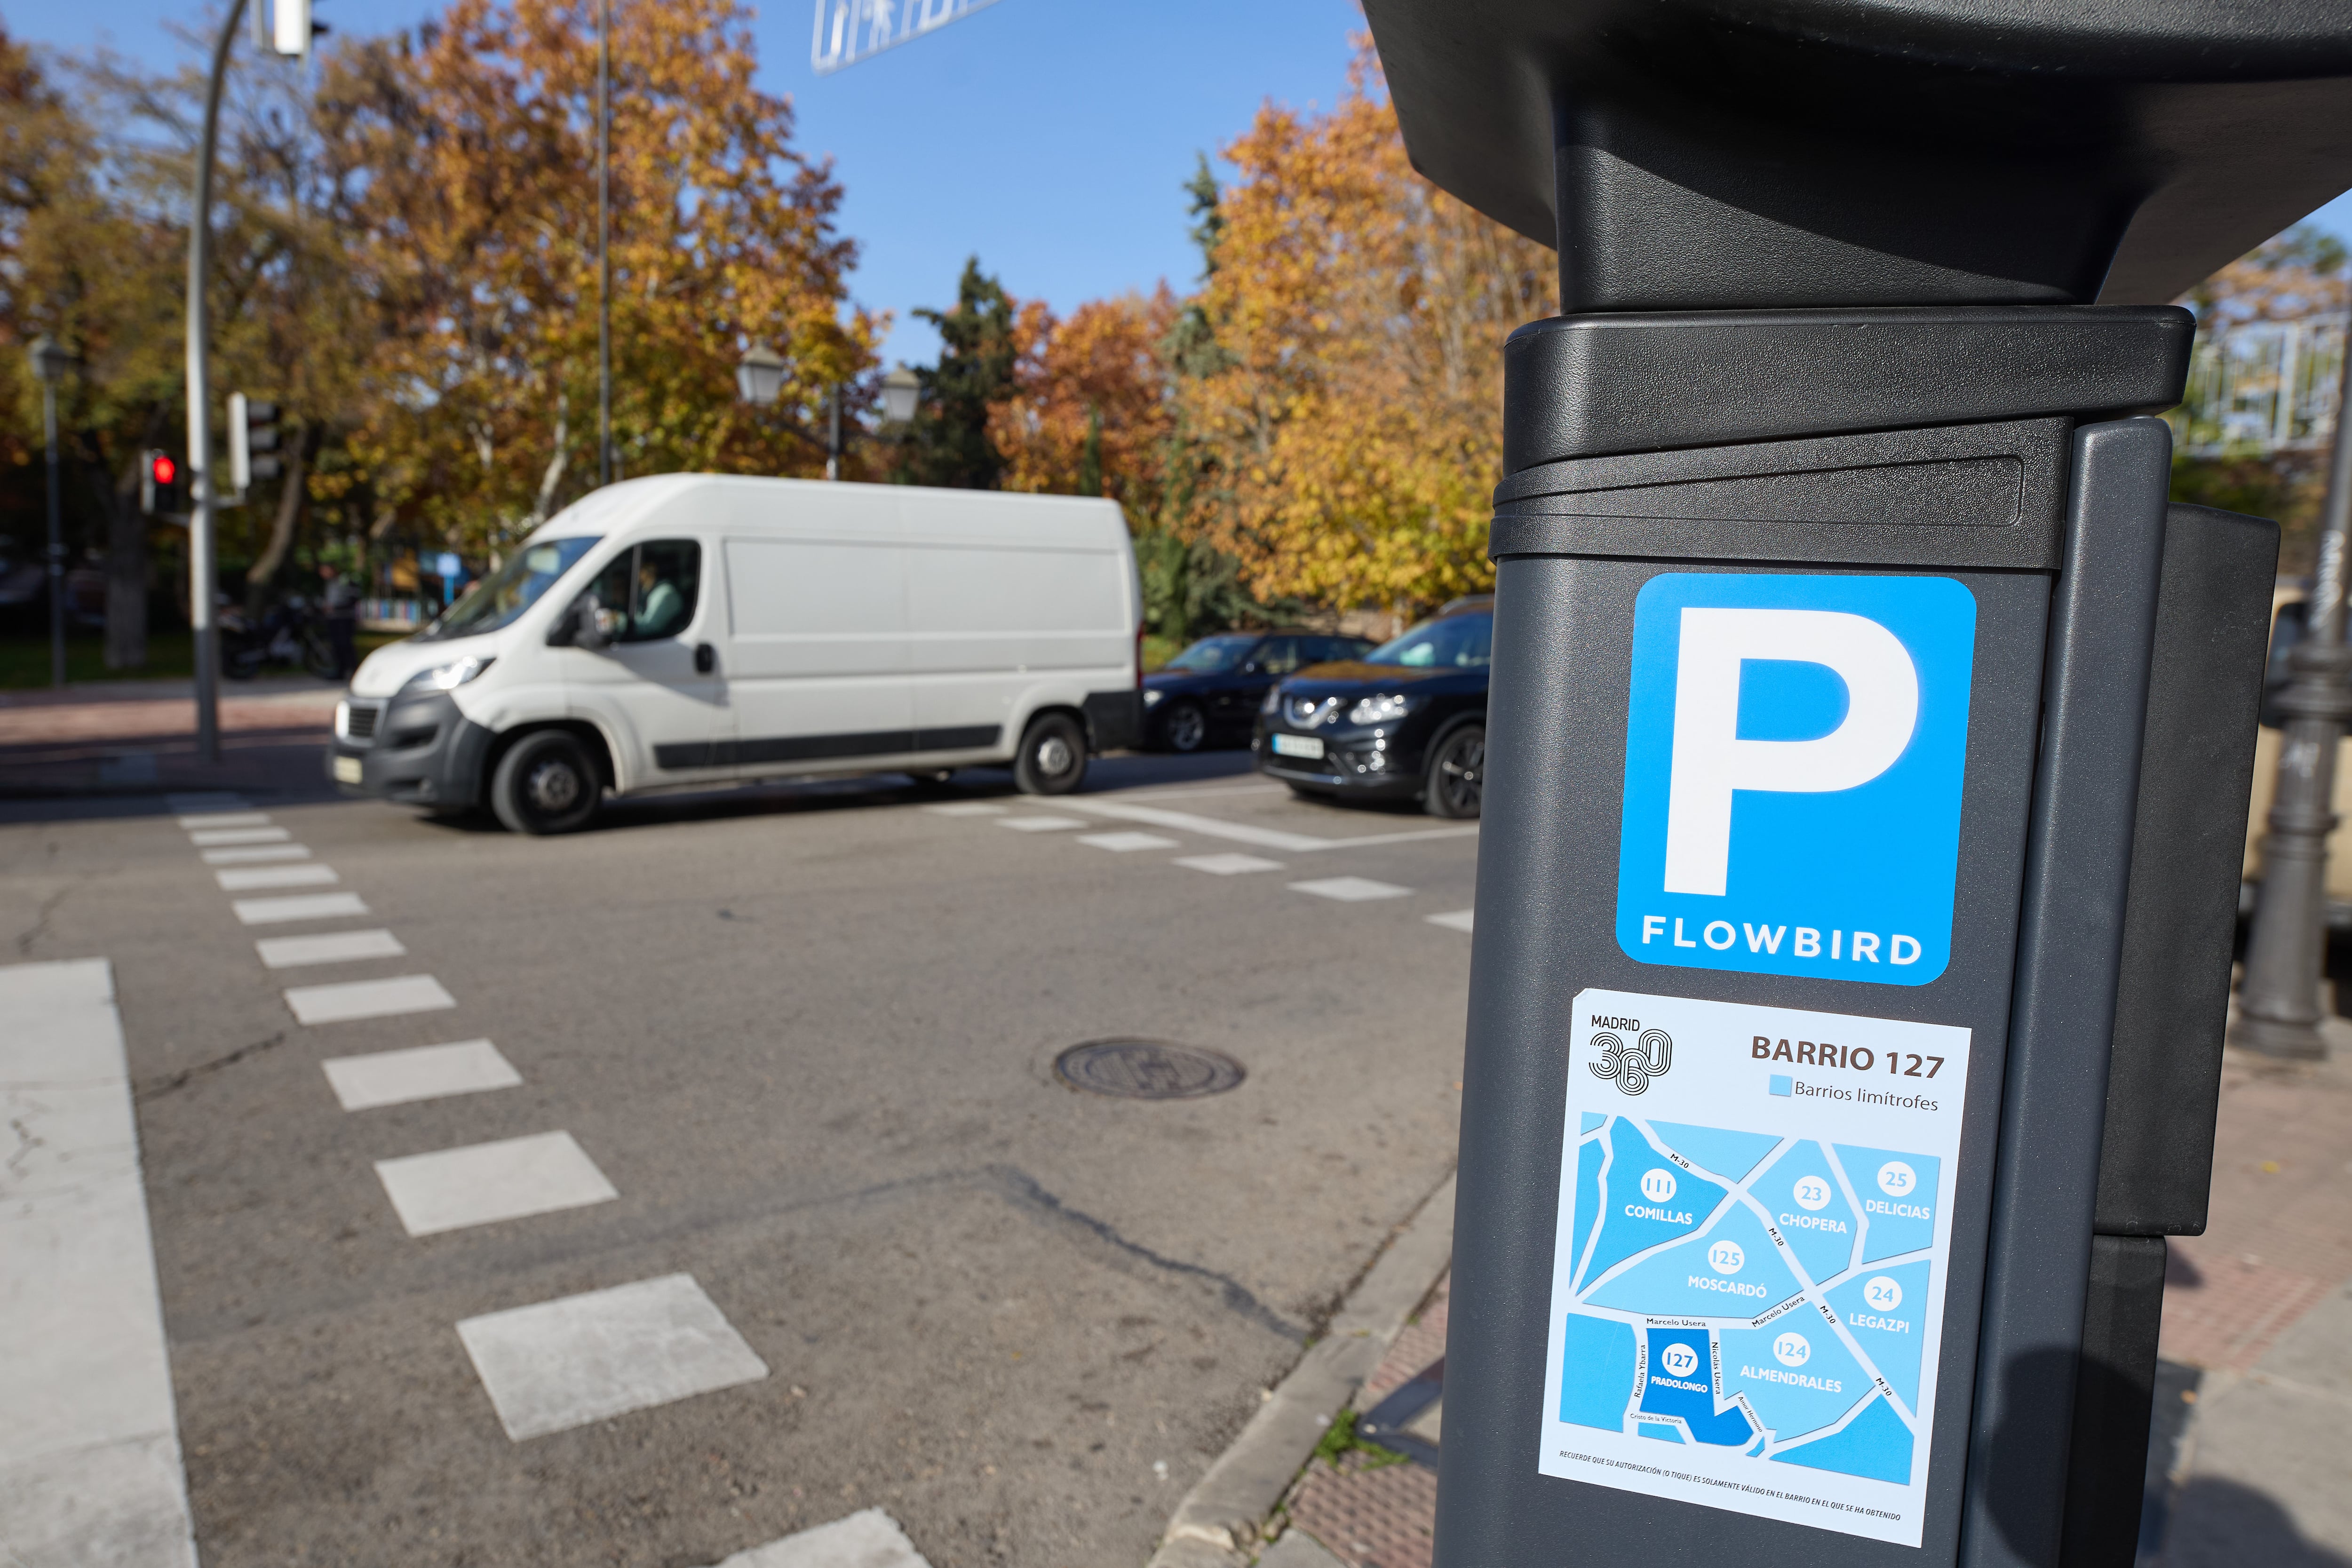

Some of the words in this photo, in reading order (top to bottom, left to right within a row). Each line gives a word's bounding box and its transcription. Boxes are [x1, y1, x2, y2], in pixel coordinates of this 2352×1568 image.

[1664, 607, 1918, 896] P
[1642, 915, 1922, 965] FLOWBIRD
[1591, 1015, 1640, 1032] MADRID
[1589, 1028, 1672, 1096] 360
[1752, 1036, 1875, 1071] BARRIO
[1887, 1051, 1945, 1079] 127
[1795, 1082, 1851, 1101] Barrios
[1857, 1088, 1938, 1111] limítrofes
[1670, 1154, 1689, 1169] M-30
[1646, 1178, 1670, 1194] 111
[1885, 1171, 1907, 1186] 25
[1801, 1186, 1822, 1201] 23
[1625, 1205, 1692, 1224] COMILLAS
[1866, 1200, 1930, 1219] DELICIAS
[1780, 1213, 1847, 1234] CHOPERA
[1769, 1228, 1783, 1246] M-30
[1713, 1250, 1740, 1266] 125
[1688, 1275, 1767, 1298] MOSCARDÓ
[1872, 1286, 1893, 1302] 24
[1752, 1309, 1782, 1328] Marcelo
[1783, 1296, 1805, 1310] Usera
[1820, 1305, 1836, 1324] M-30
[1849, 1313, 1909, 1333] LEGAZPI
[1778, 1341, 1806, 1358] 124
[1667, 1352, 1693, 1368] 127
[1635, 1371, 1645, 1398] Rafaela
[1651, 1376, 1708, 1393] PRADOLONGO
[1740, 1365, 1842, 1393] ALMENDRALES
[1875, 1377, 1892, 1396] M-30
[1738, 1396, 1749, 1410] Amor
[1747, 1410, 1762, 1433] Hermoso
[1559, 1450, 1591, 1462] RECUERDE
[1615, 1461, 1661, 1475] AUTORIZACIÓN
[1671, 1472, 1692, 1482] TIQUE)
[1702, 1477, 1740, 1490] SOLAMENTE
[1741, 1484, 1764, 1495] VÁLIDO
[1785, 1493, 1810, 1503] BARRIO
[1866, 1509, 1900, 1520] OBTENIDO
